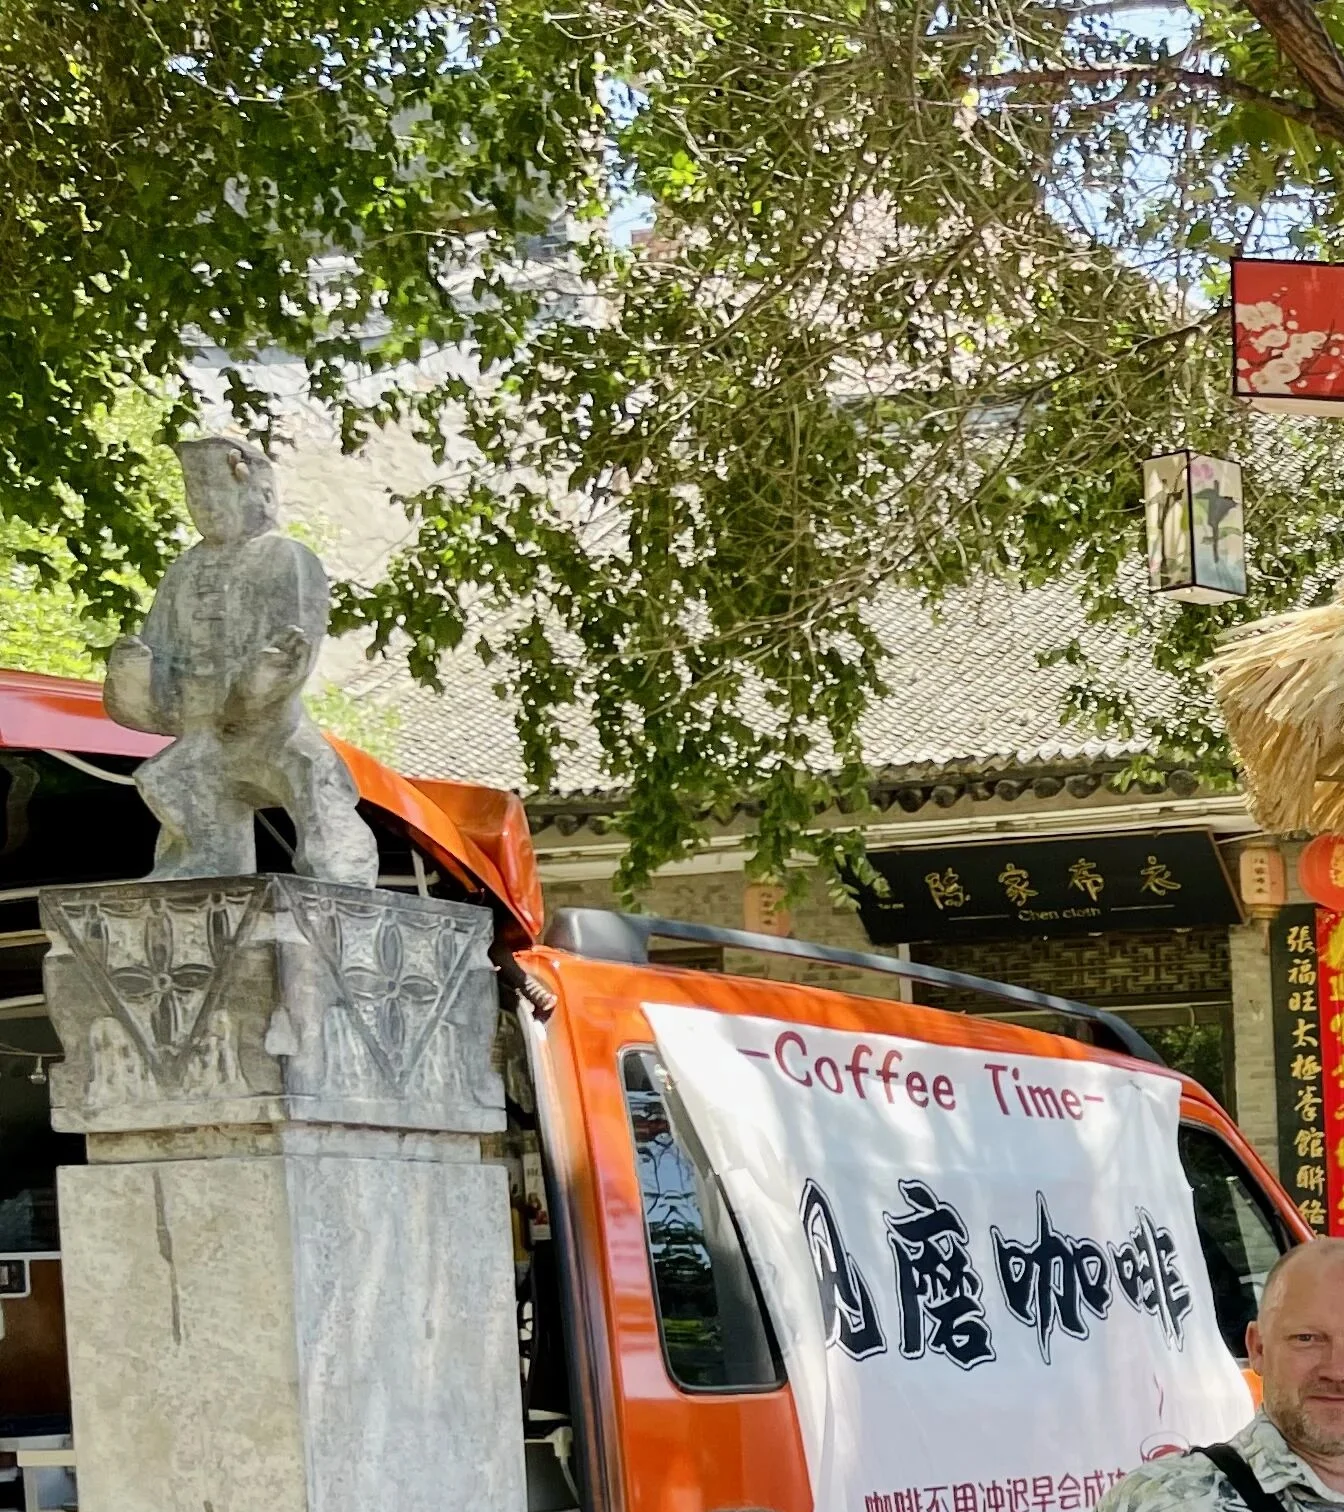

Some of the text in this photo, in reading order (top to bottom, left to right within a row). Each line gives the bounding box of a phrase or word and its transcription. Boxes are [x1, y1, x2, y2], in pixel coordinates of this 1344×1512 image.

[1285, 925, 1328, 1239] 張福旺太極拳館聯絡
